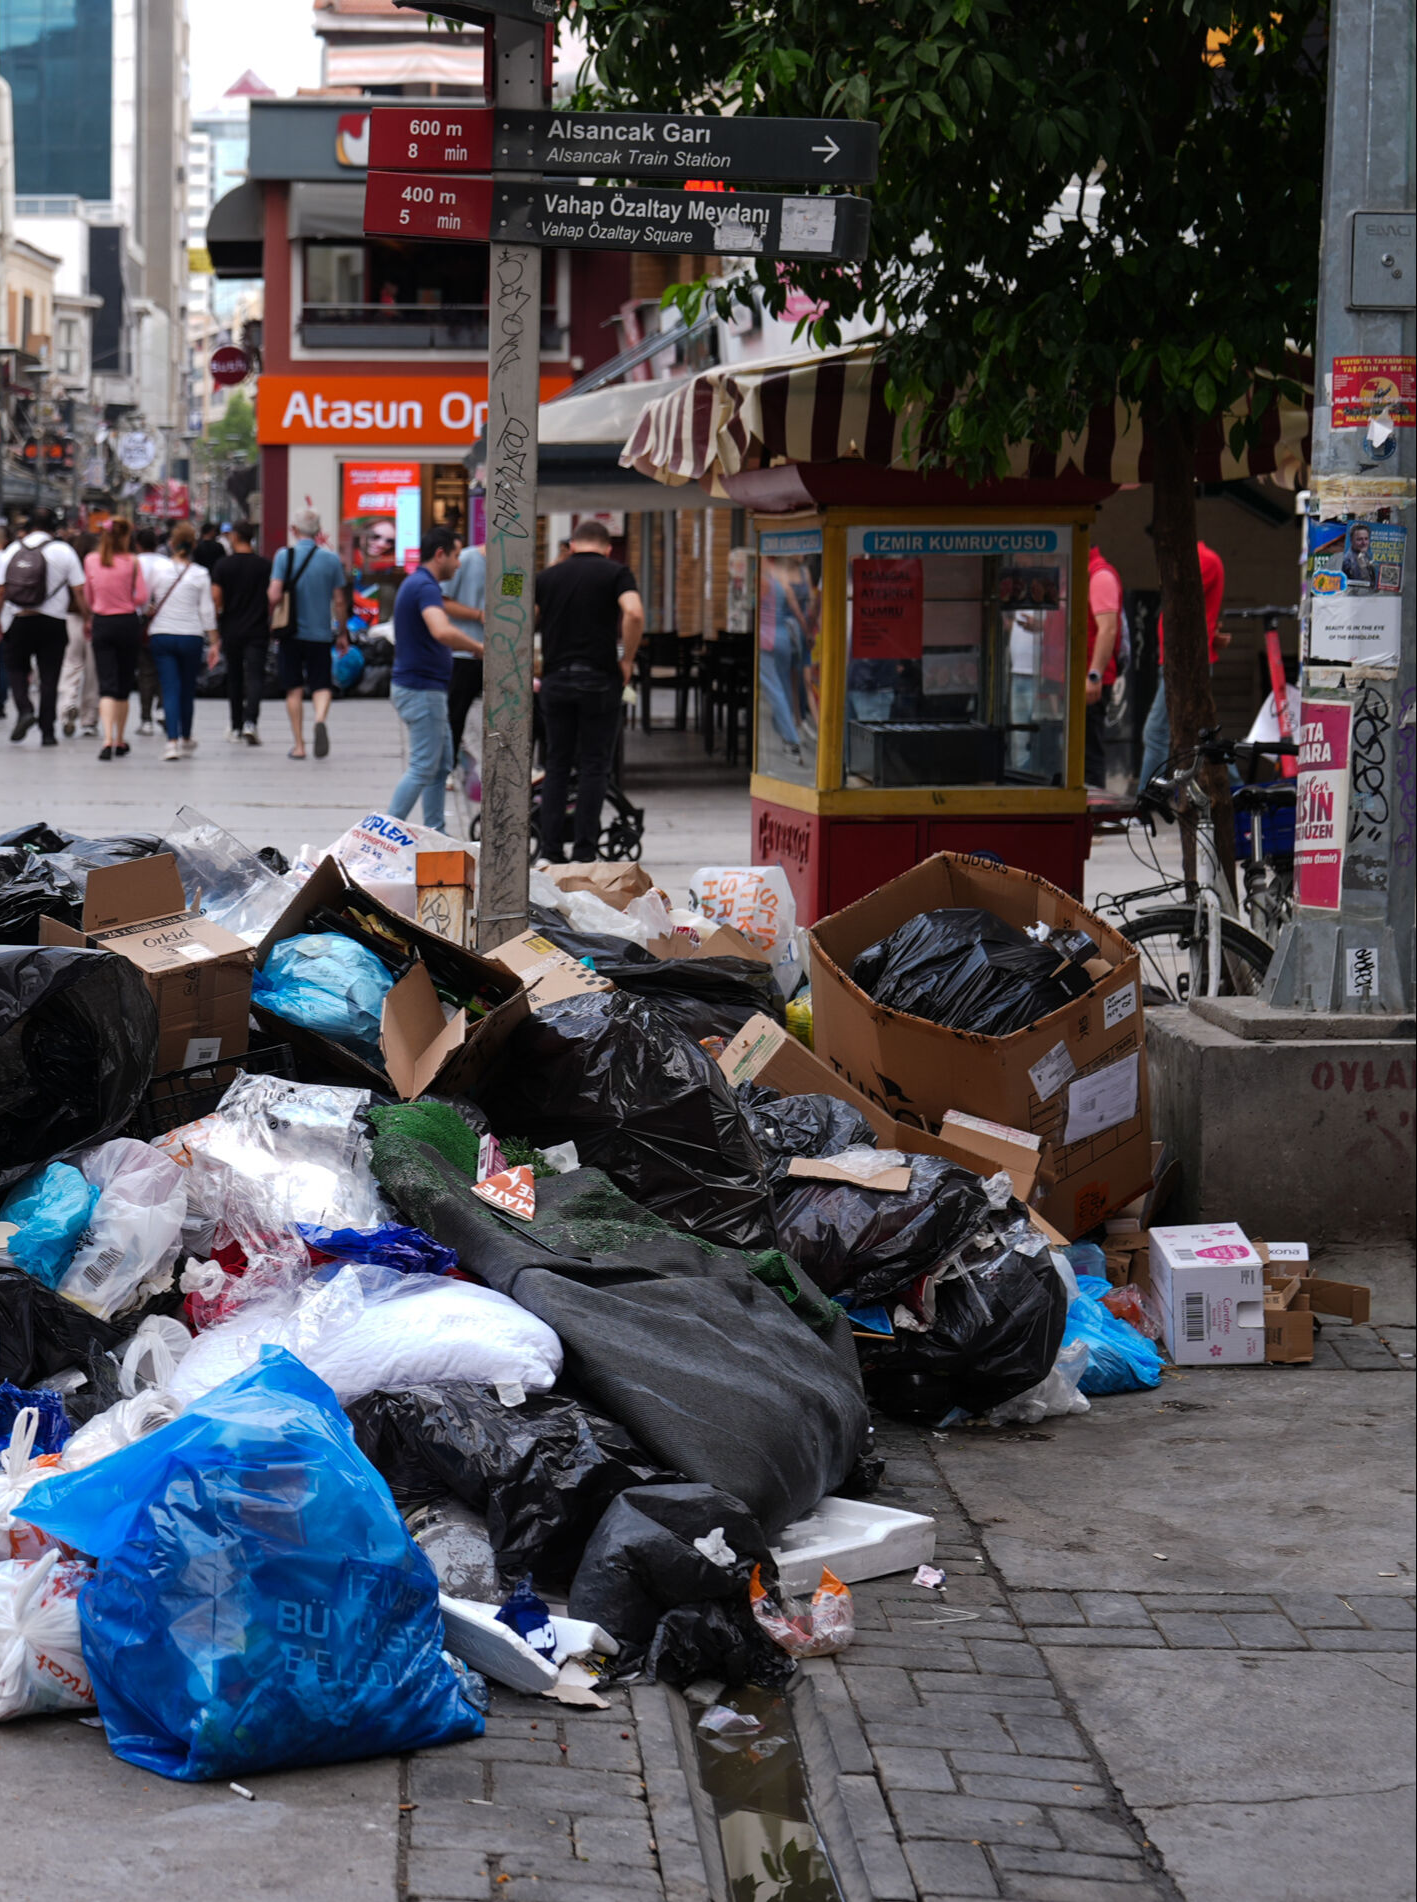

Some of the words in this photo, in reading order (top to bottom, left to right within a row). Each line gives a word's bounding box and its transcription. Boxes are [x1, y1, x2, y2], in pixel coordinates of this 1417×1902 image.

[409, 120, 441, 135] 600
[446, 123, 463, 136] m
[547, 119, 655, 142] Alsancak
[662, 122, 711, 143] Garı
[407, 143, 418, 158] 8
[444, 144, 468, 161] min
[546, 147, 622, 165] Alsancak
[628, 149, 669, 166] Train
[673, 151, 731, 168] Station
[401, 186, 434, 203] 400
[439, 190, 457, 204] m
[399, 209, 410, 225] 5
[437, 213, 461, 230] min
[544, 194, 604, 220] Vahap
[609, 192, 682, 224] Özaltay
[688, 200, 770, 227] Meydanı
[541, 221, 584, 239] Vahap
[588, 221, 640, 243] Özaltay
[644, 228, 693, 244] Square
[282, 391, 423, 429] Atasun
[874, 533, 923, 550] İZMİR
[929, 535, 1047, 550] KUMRU'CUSU
[360, 844, 371, 854] 25
[954, 852, 1009, 875] TUDORS
[105, 929, 120, 939] 24
[142, 927, 194, 948] Orkid
[263, 1088, 313, 1106] TUDORS
